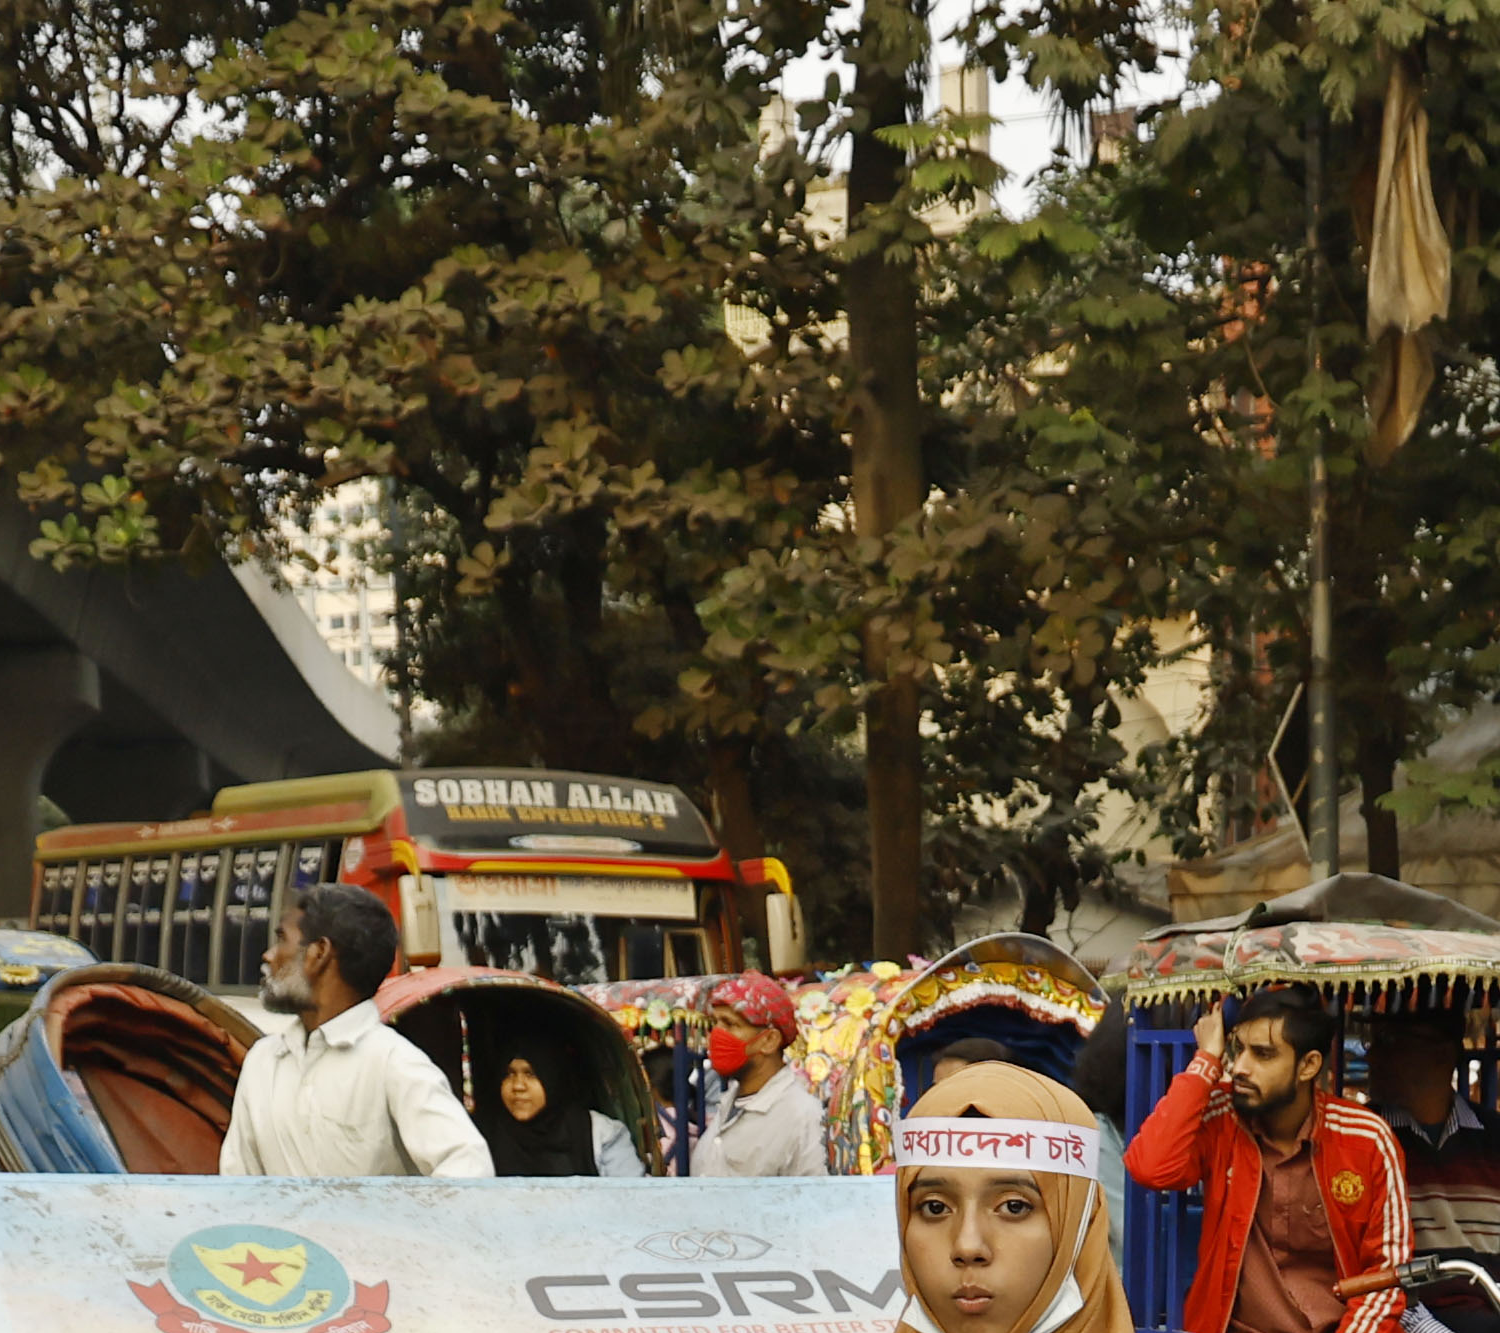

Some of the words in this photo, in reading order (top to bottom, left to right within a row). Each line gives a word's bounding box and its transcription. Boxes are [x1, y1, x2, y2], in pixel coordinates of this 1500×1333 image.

[412, 778, 557, 807] SOBHAN
[567, 782, 678, 817] ALLAH
[902, 1127, 1036, 1159] অধ্যাদেশ
[1044, 1129, 1086, 1169] চাই
[525, 1268, 908, 1321] CSRM
